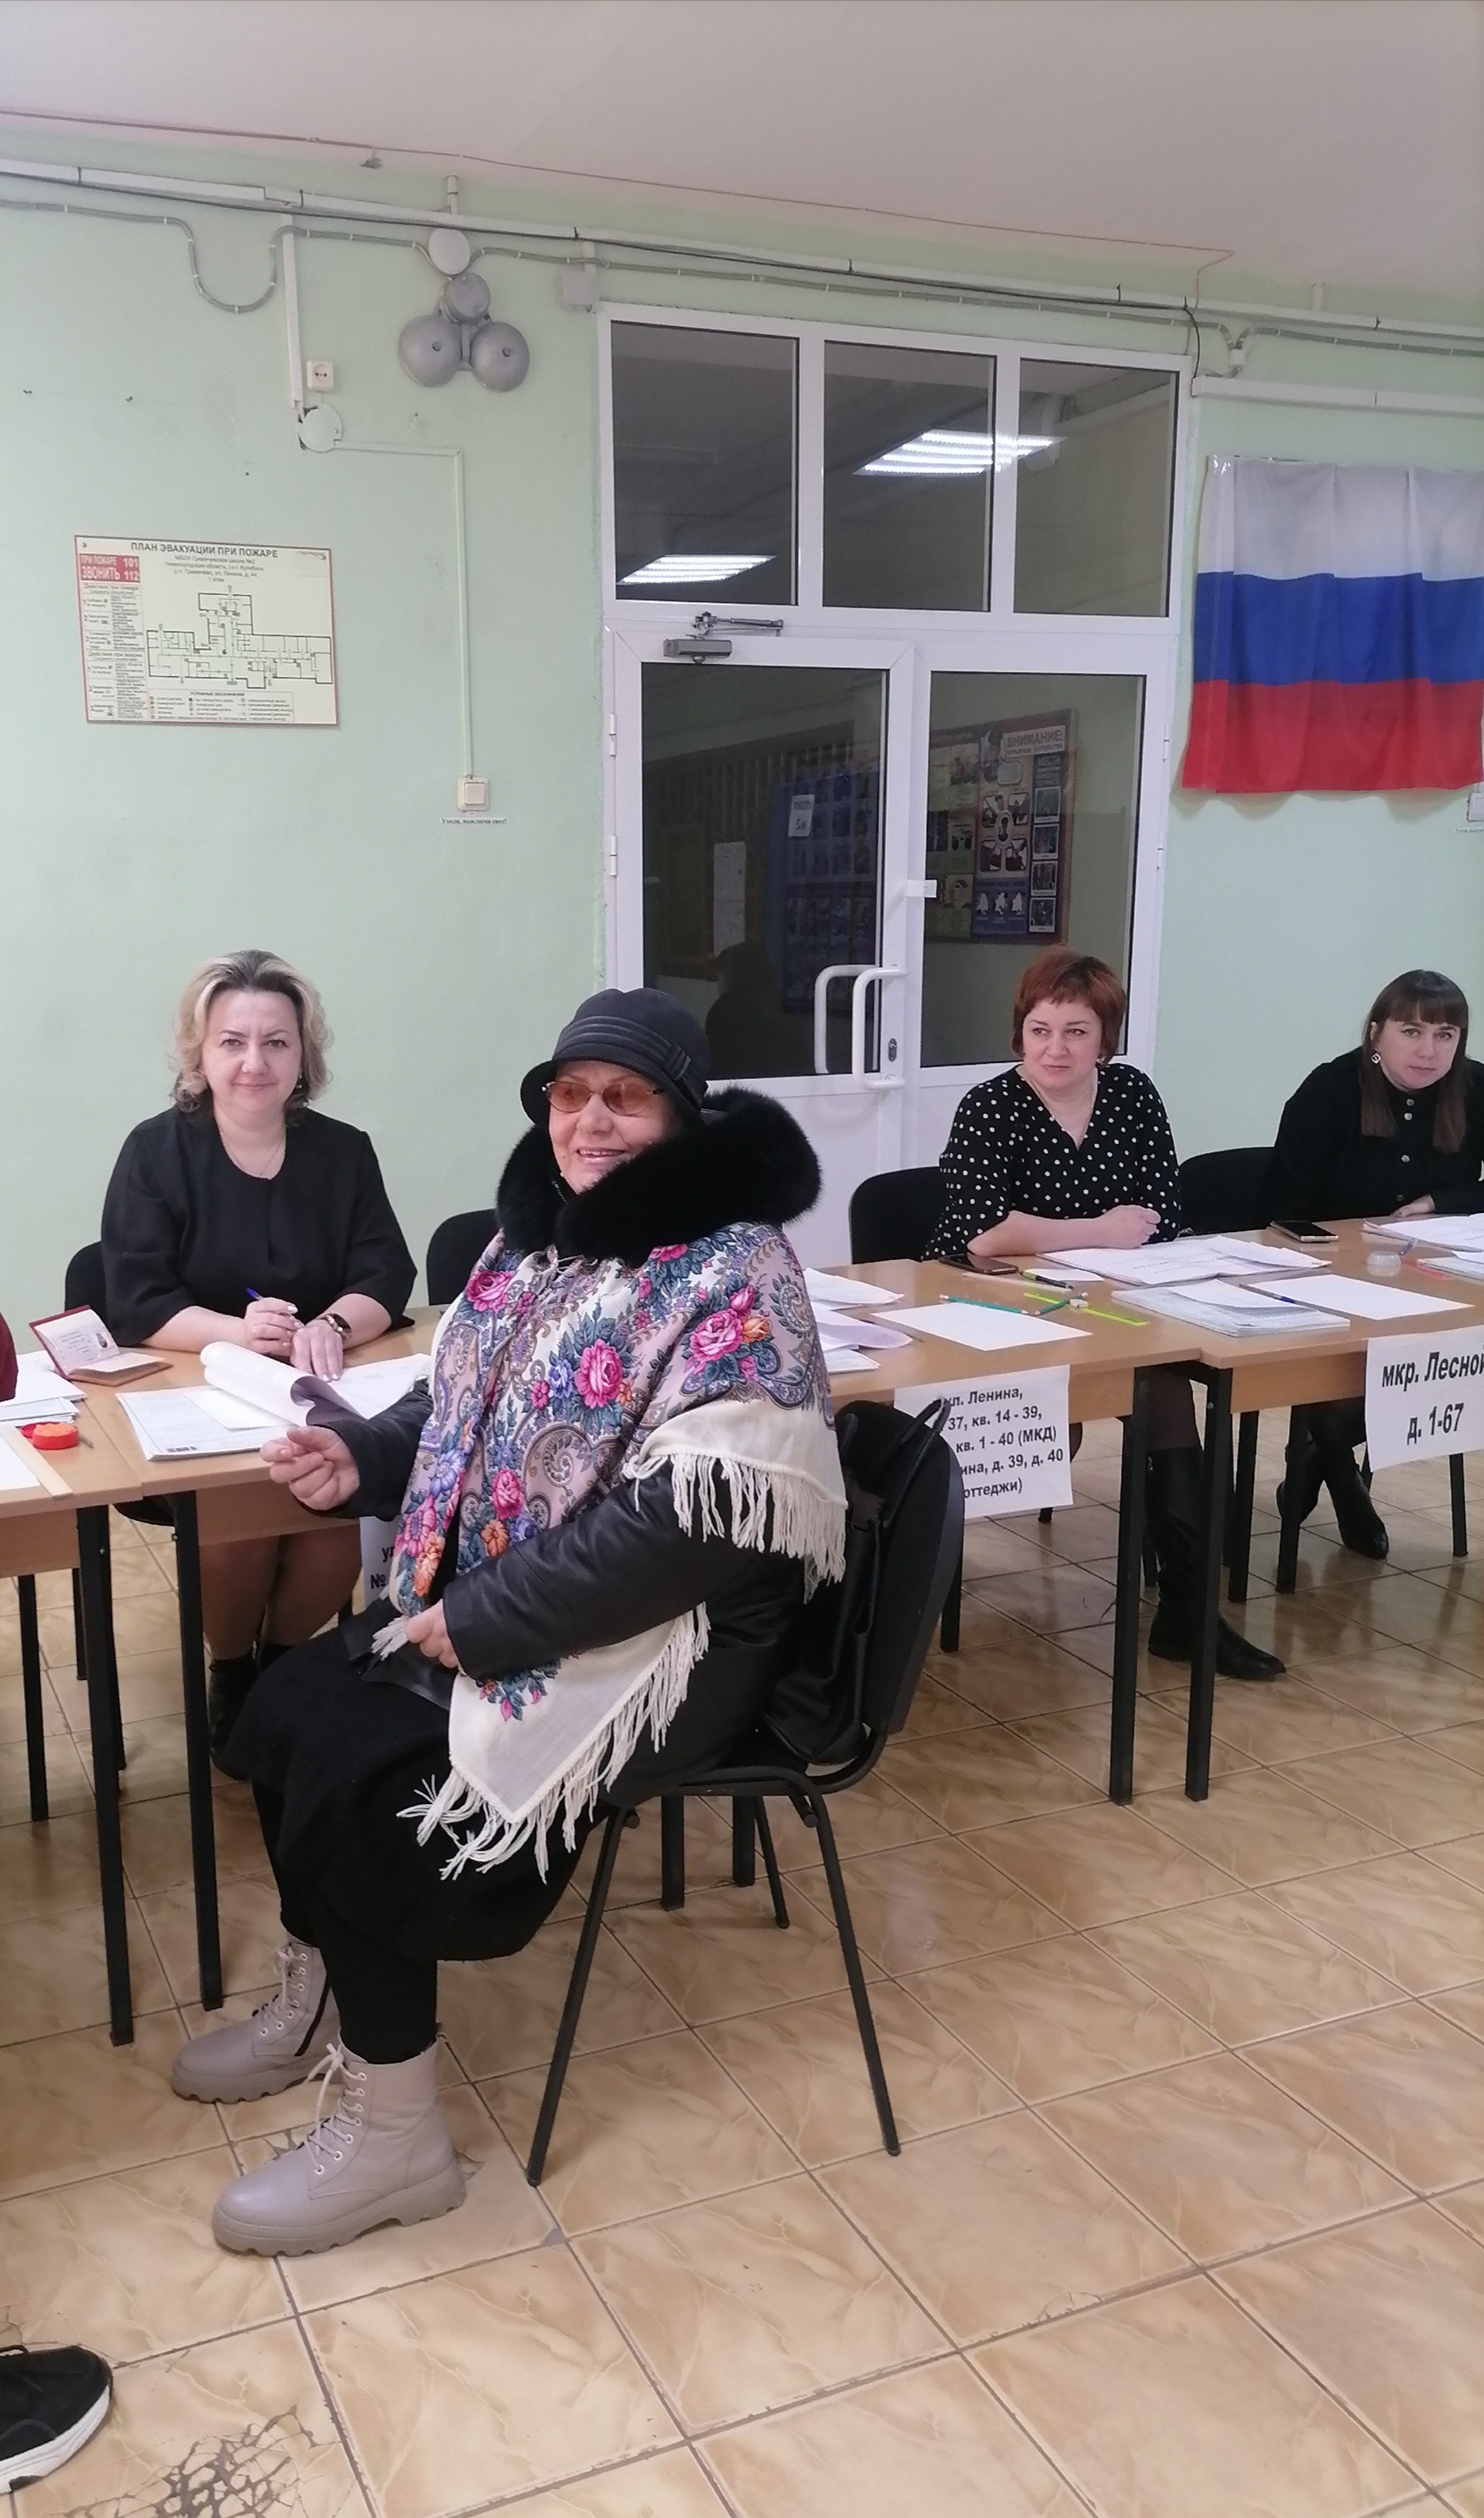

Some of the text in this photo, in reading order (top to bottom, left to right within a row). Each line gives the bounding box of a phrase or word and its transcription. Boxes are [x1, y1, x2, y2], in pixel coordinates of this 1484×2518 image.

[81, 555, 138, 568] ПРИ ПОЖАРЕ 101
[130, 542, 278, 558] ПЛАН ЭВАКУАЦИИ ПРИ ПОЖАРЕ
[82, 566, 140, 581] ЗВОНИТЬ 112
[1382, 1362, 1419, 1391] мкр.
[968, 1388, 1023, 1405] Ленина,
[948, 1416, 968, 1431] 37,
[972, 1416, 991, 1428] кв.
[996, 1409, 1010, 1423] 14
[1022, 1406, 1042, 1420] 39,
[1407, 1403, 1464, 1445] д. 1-67
[957, 1441, 975, 1453] кв.
[979, 1436, 986, 1449] 1
[999, 1432, 1014, 1445] 40
[1018, 1425, 1056, 1446] (МКД)
[991, 1460, 1004, 1474] д.
[1008, 1454, 1027, 1469] 39,
[1031, 1453, 1044, 1466] д.
[1048, 1449, 1063, 1462] 40
[964, 1477, 1023, 1499] оттеджи)
